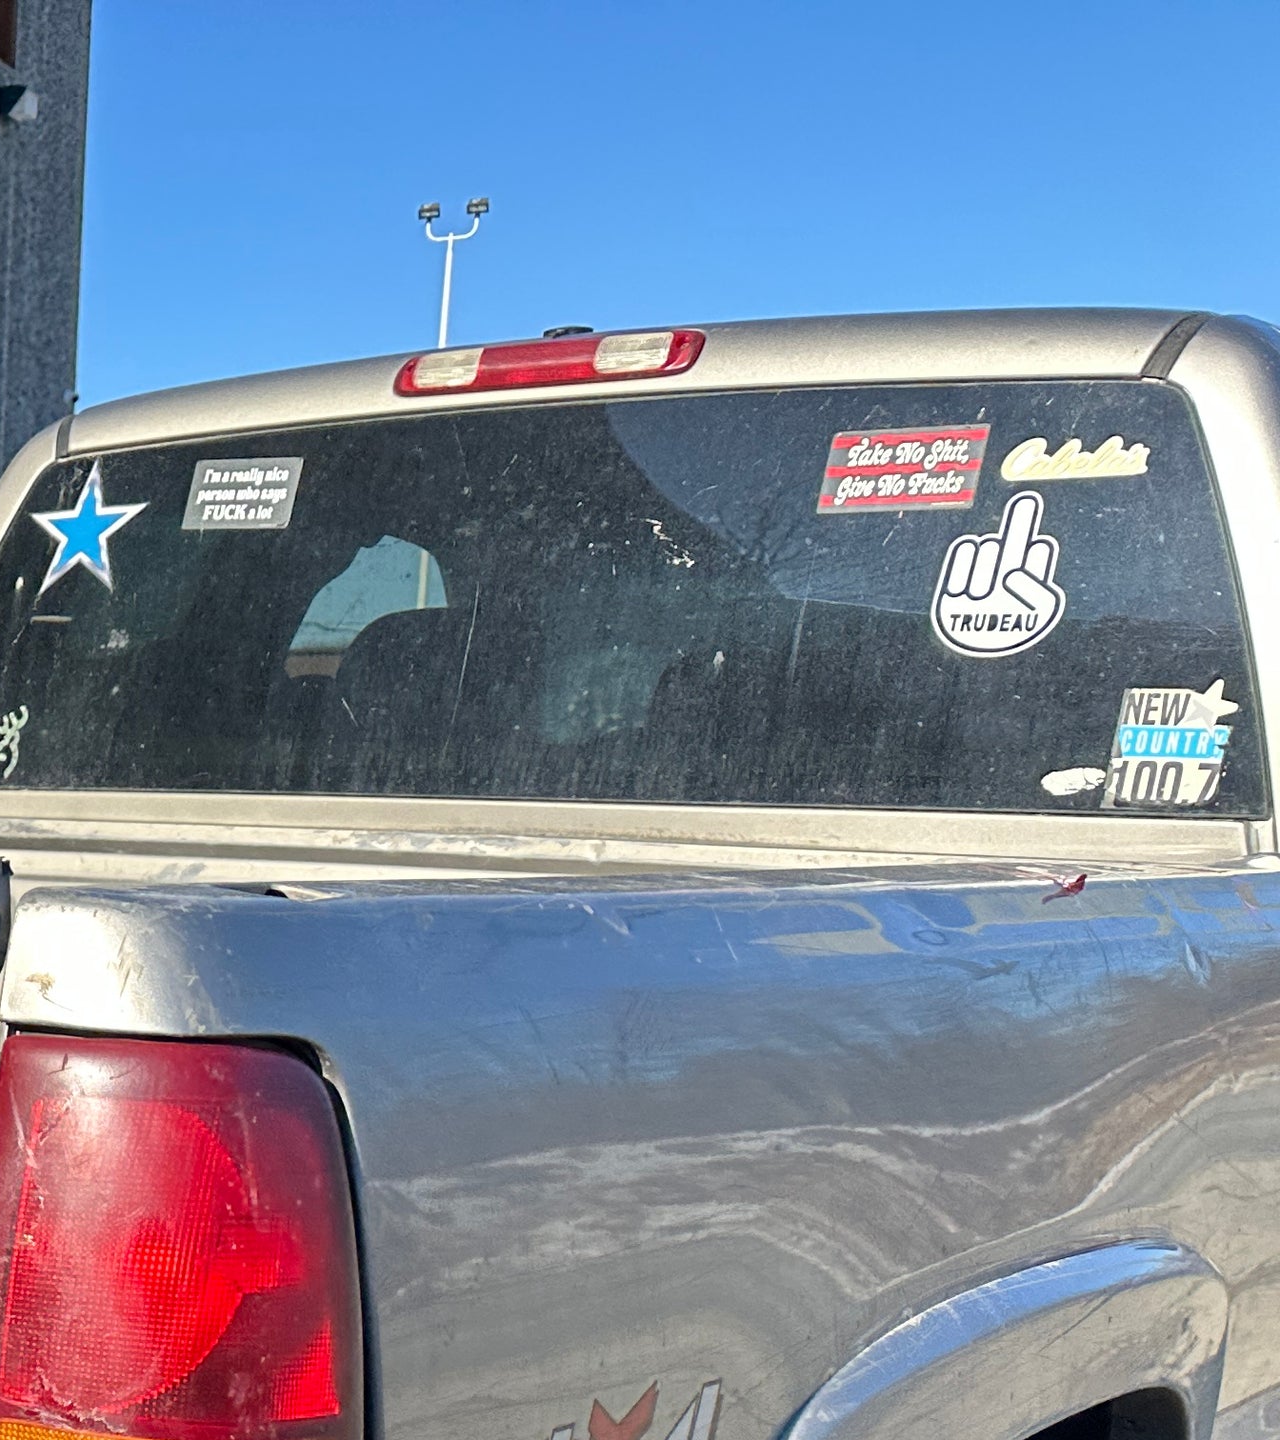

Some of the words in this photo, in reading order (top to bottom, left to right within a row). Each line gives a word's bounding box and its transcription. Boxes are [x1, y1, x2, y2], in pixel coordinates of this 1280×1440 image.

[847, 437, 893, 467] Take
[896, 441, 926, 465] No
[923, 438, 970, 470] Shit,
[203, 468, 221, 484] I'm
[230, 467, 265, 486] really
[264, 466, 290, 481] nice
[833, 475, 875, 506] Give
[877, 473, 906, 497] No
[908, 470, 965, 496] Fucks
[196, 488, 236, 505] person
[236, 485, 260, 501] who
[260, 486, 288, 504] says
[202, 504, 248, 521] FUCK
[256, 505, 274, 519] lot
[949, 613, 1039, 633] TRUDEAU
[1122, 692, 1192, 726] NEW
[1121, 730, 1227, 758] COUNTRY
